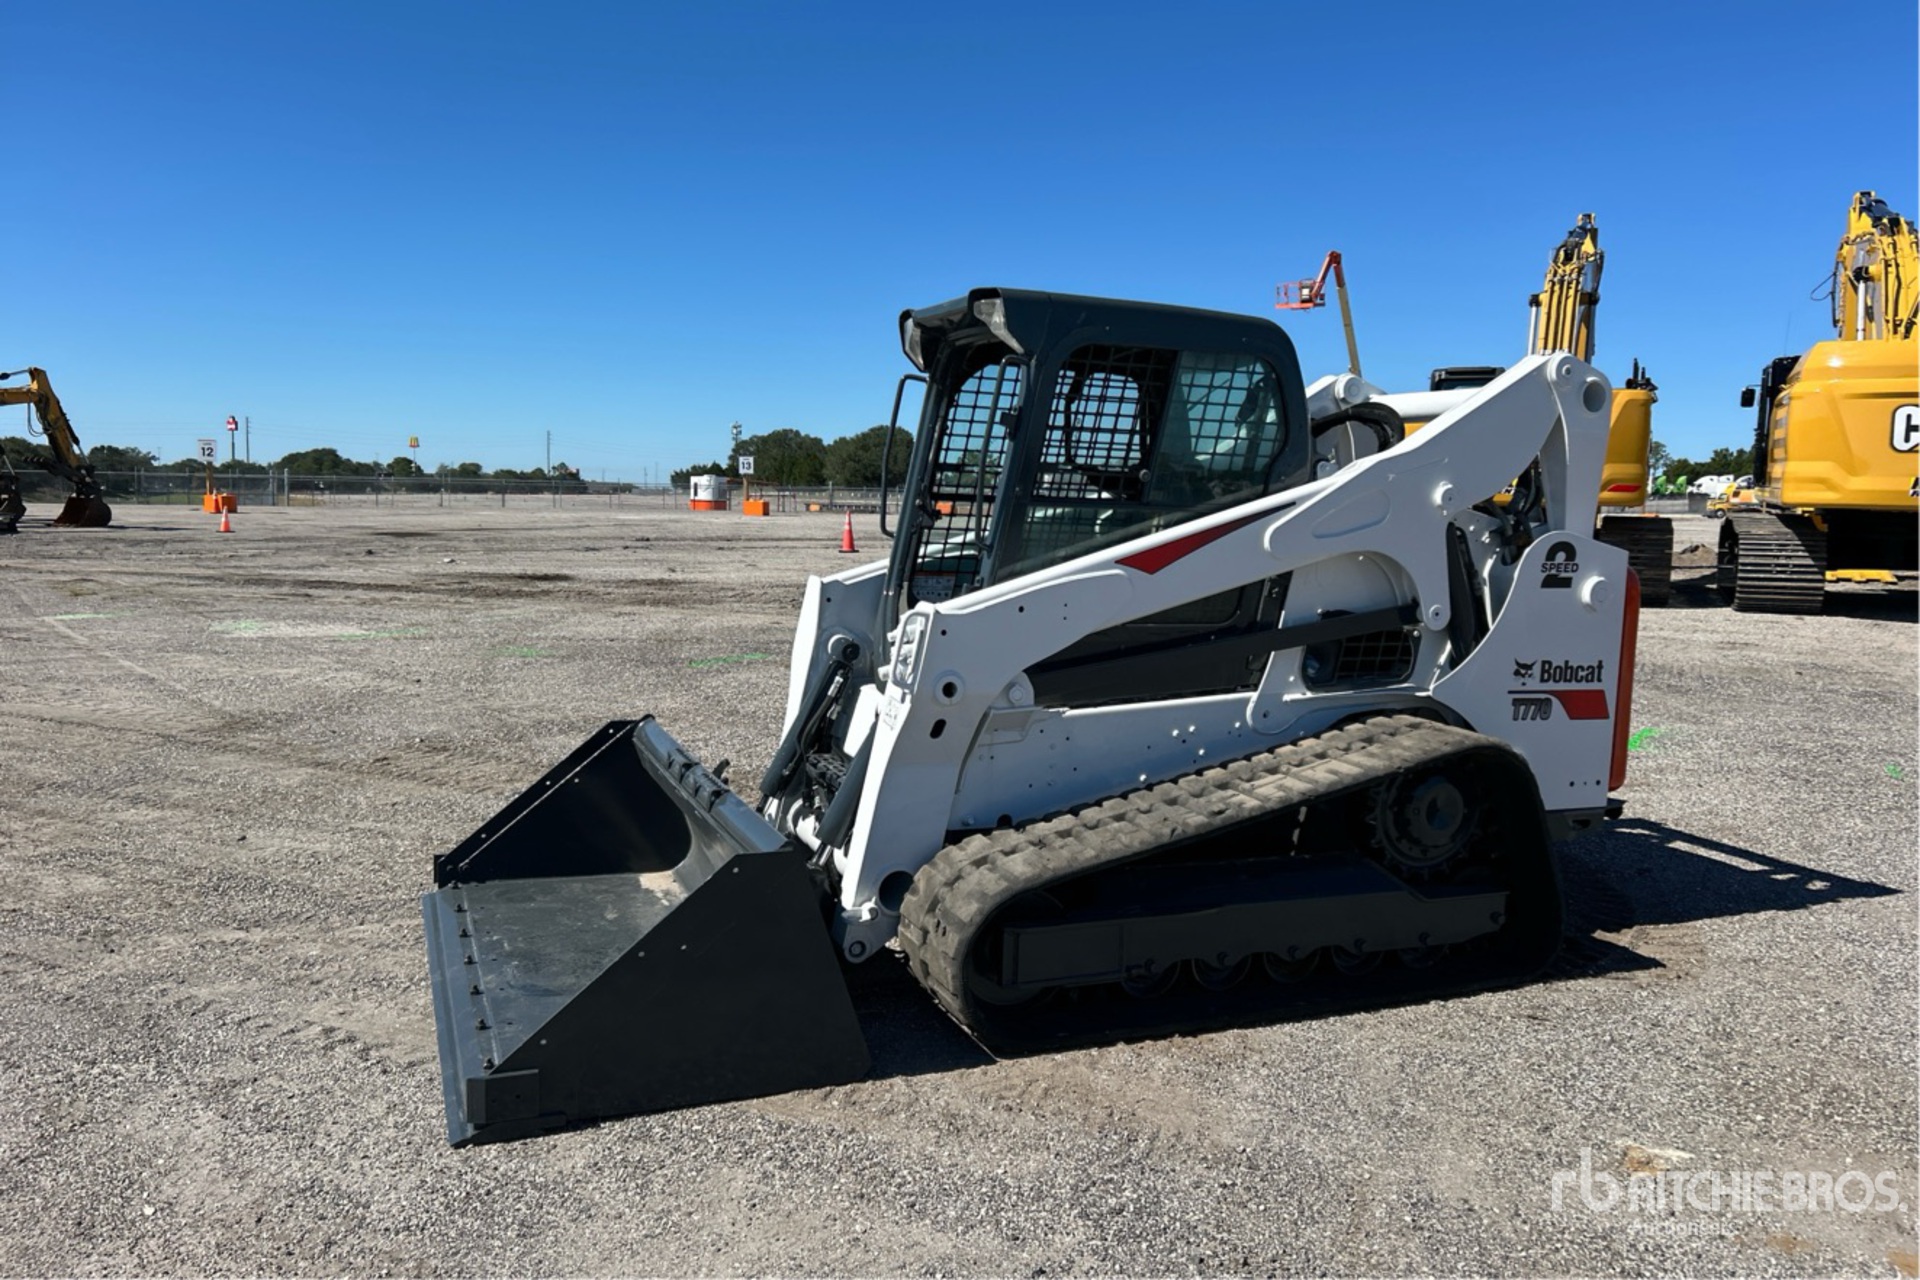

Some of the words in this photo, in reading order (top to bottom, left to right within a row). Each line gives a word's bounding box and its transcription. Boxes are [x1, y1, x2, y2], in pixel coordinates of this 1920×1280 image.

[201, 446, 214, 457] 12
[741, 461, 752, 471] 13
[1540, 541, 1577, 588] 2
[1541, 562, 1579, 573] SPEED
[1539, 660, 1604, 683] Bobcat
[1511, 697, 1553, 721] T770
